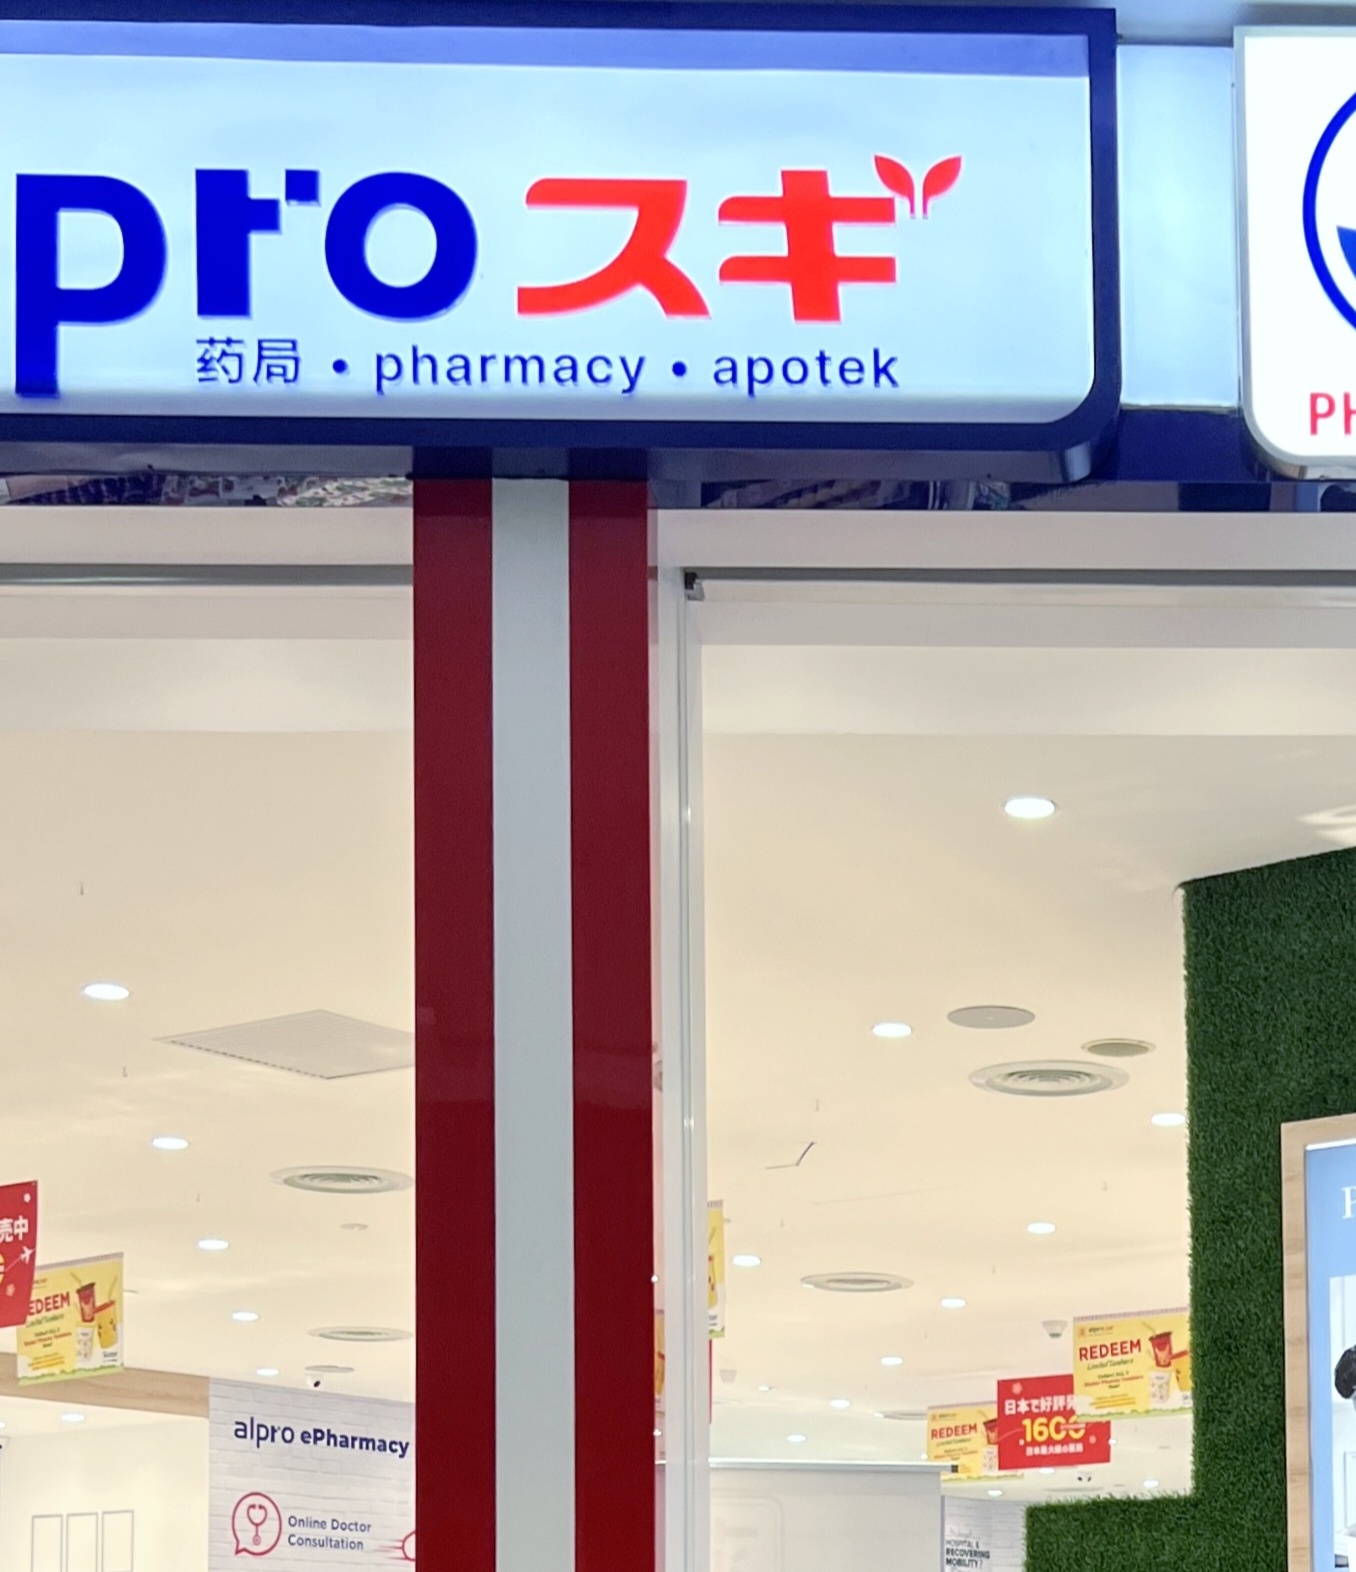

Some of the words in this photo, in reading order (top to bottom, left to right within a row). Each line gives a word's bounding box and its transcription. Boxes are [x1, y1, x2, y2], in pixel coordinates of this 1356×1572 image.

[196, 339, 302, 385] 药局
[375, 346, 646, 395] pharmacy
[712, 346, 899, 389] apotek
[28, 1292, 70, 1316] EDEEM
[1079, 1339, 1142, 1361] REDEEM
[234, 1417, 295, 1448] alpro
[300, 1429, 410, 1458] ePharmacy
[931, 1423, 978, 1440] REDEEM
[288, 1515, 327, 1530] Online
[331, 1518, 371, 1533] Doctor
[288, 1534, 364, 1550] Consultation
[946, 1548, 990, 1559] RECOVERING
